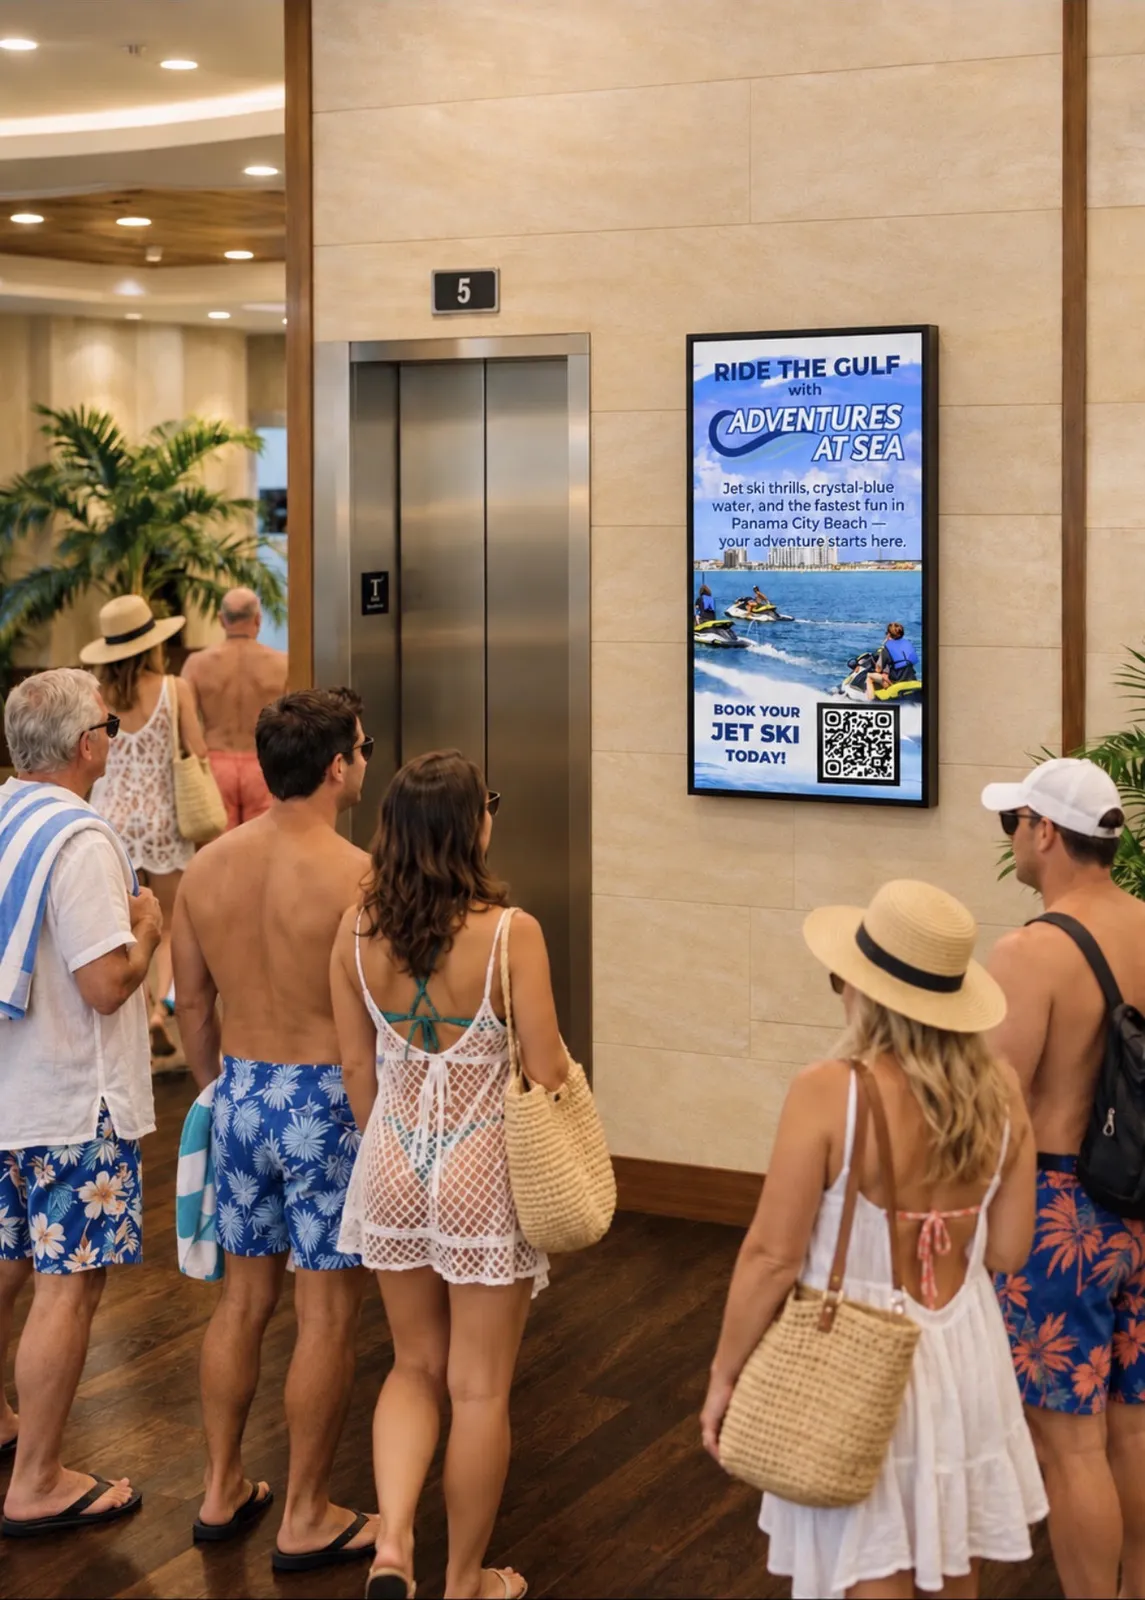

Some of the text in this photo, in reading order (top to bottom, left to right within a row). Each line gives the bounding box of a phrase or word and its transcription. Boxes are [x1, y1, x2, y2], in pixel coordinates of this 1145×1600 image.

[457, 277, 471, 304] 5
[714, 355, 900, 382] RIDE THE GULF
[788, 383, 822, 396] with
[726, 403, 905, 435] ADVENTURES
[811, 433, 905, 462] AT SEA
[722, 480, 895, 497] Jet ski thrills, crystal-blue
[712, 498, 905, 514] water, and the fastest fun in
[731, 517, 788, 530] Panama
[792, 516, 819, 532] City
[824, 516, 868, 530] Beach
[719, 534, 907, 550] your adventure starts here.
[713, 704, 800, 718] BOOK YOUR
[711, 722, 800, 744] JET SKI
[725, 749, 786, 765] TODAY!
